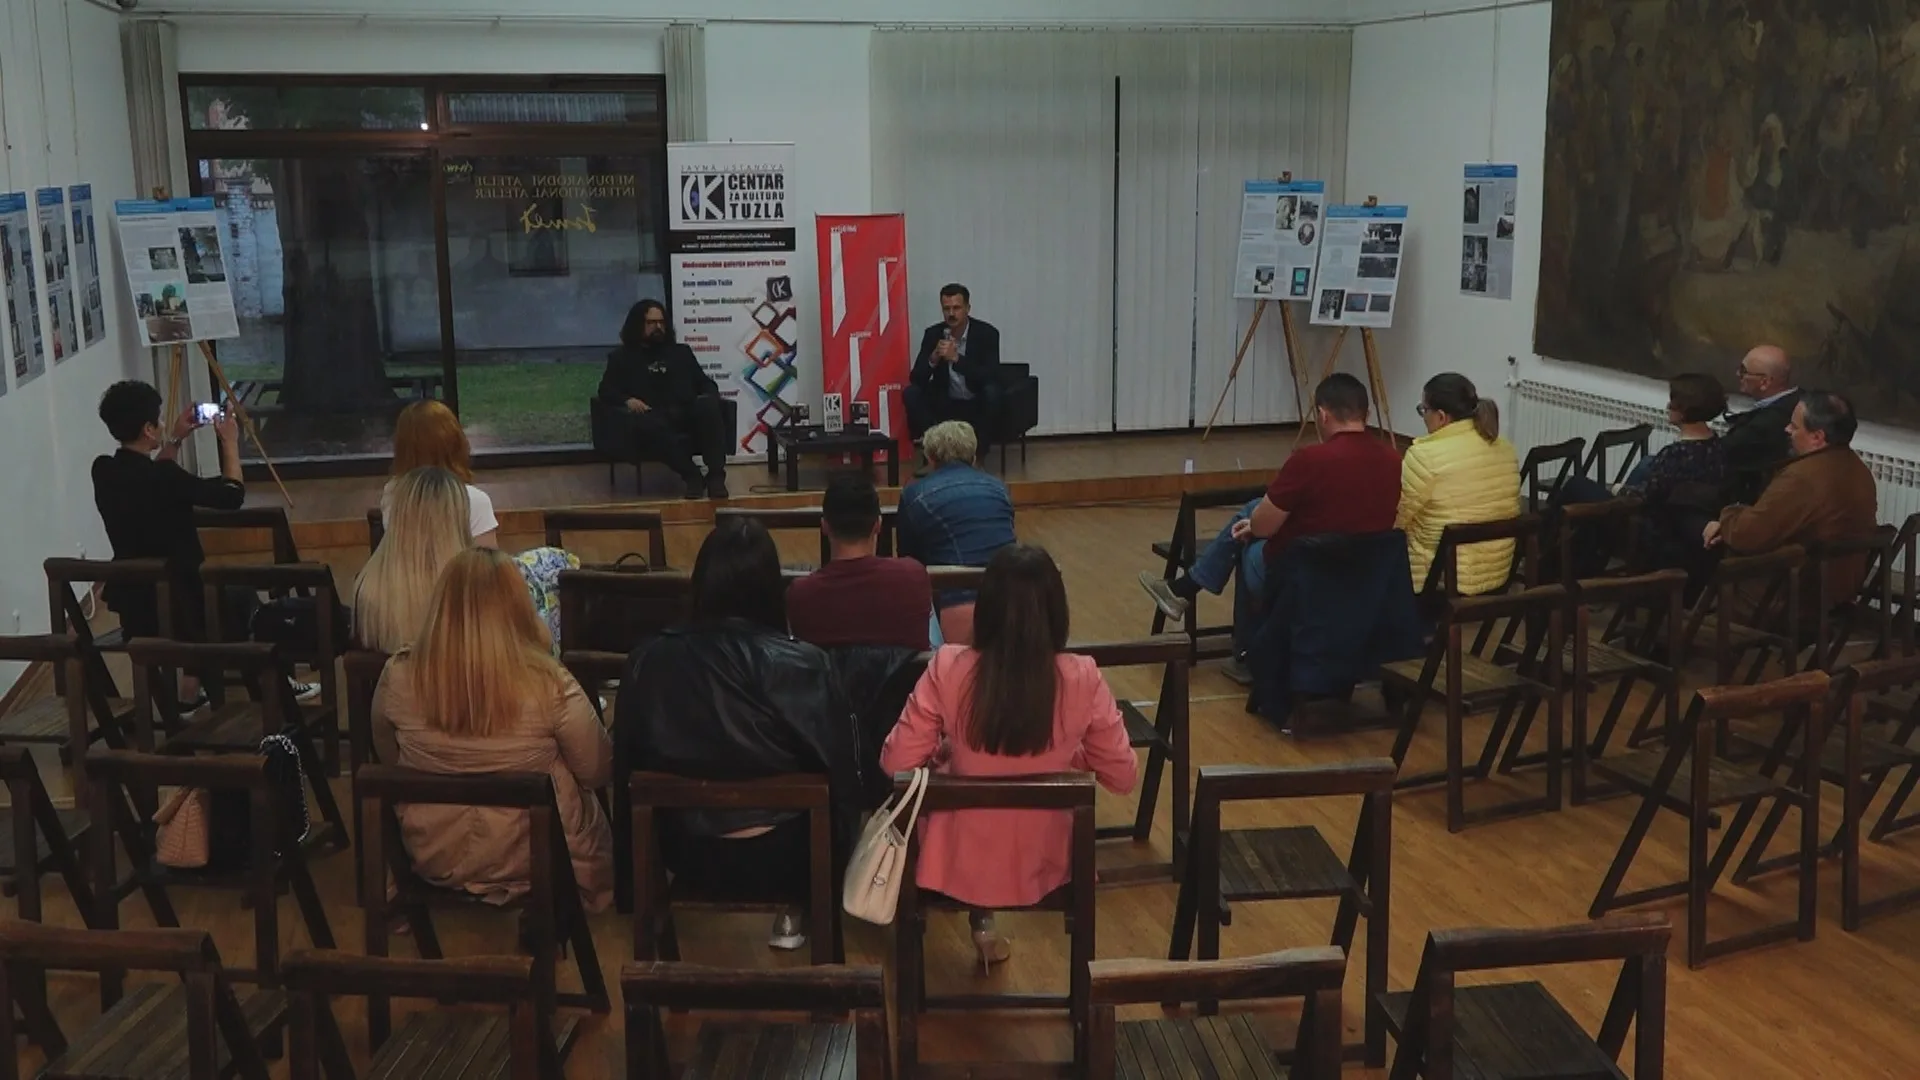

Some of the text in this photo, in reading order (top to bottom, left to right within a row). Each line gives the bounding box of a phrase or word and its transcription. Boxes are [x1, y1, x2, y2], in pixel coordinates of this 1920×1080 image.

[723, 163, 784, 172] USTANOVA
[728, 173, 784, 190] CENTAR
[729, 191, 785, 201] ZA KULTURU
[730, 203, 784, 219] TUZLA
